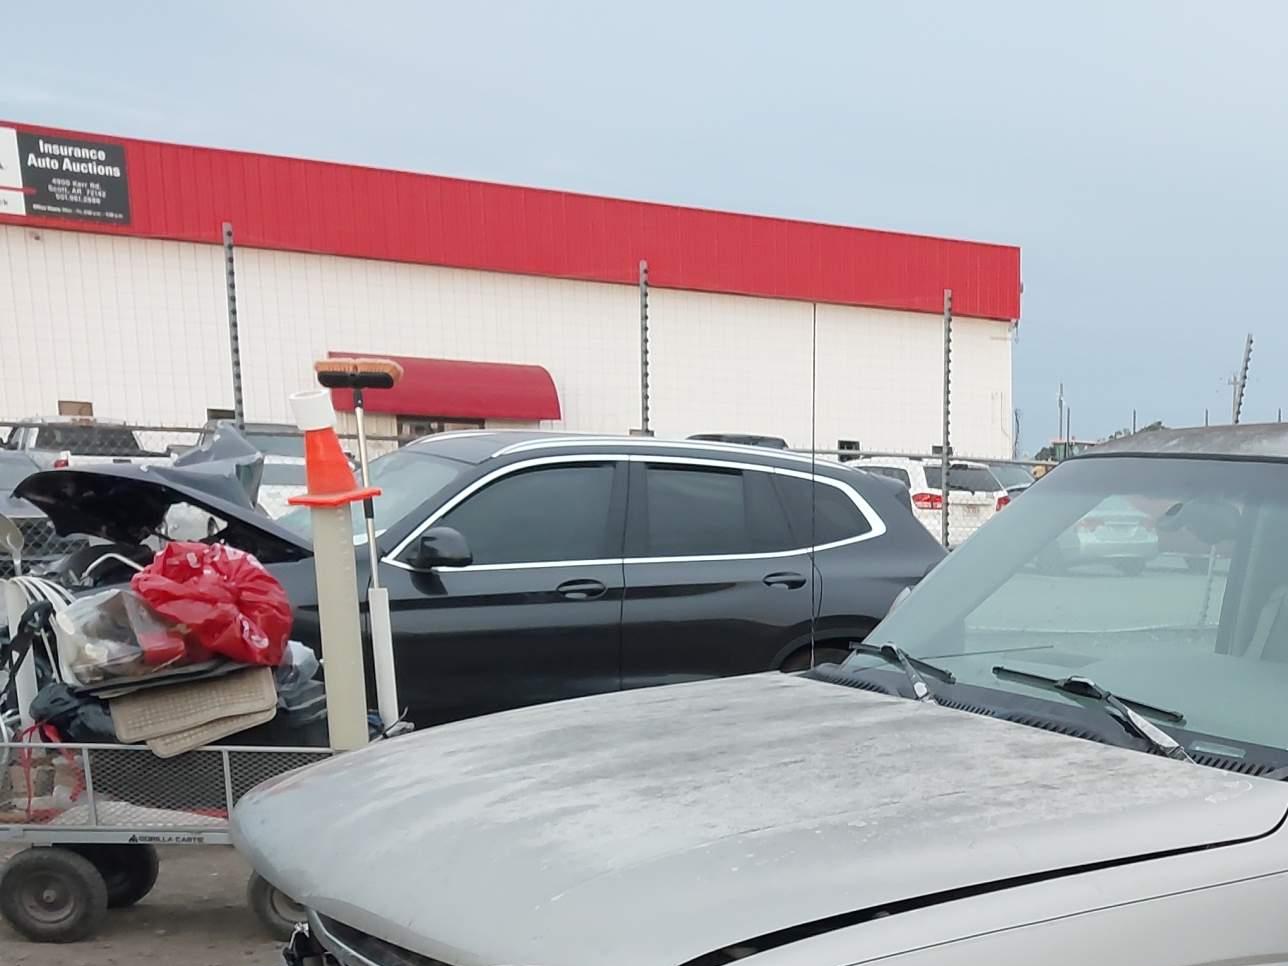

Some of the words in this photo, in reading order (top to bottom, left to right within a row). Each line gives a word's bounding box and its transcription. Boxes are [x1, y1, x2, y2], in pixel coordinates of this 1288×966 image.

[39, 139, 106, 161] Insurance
[27, 153, 59, 170] Auto
[62, 158, 121, 177] Auctions
